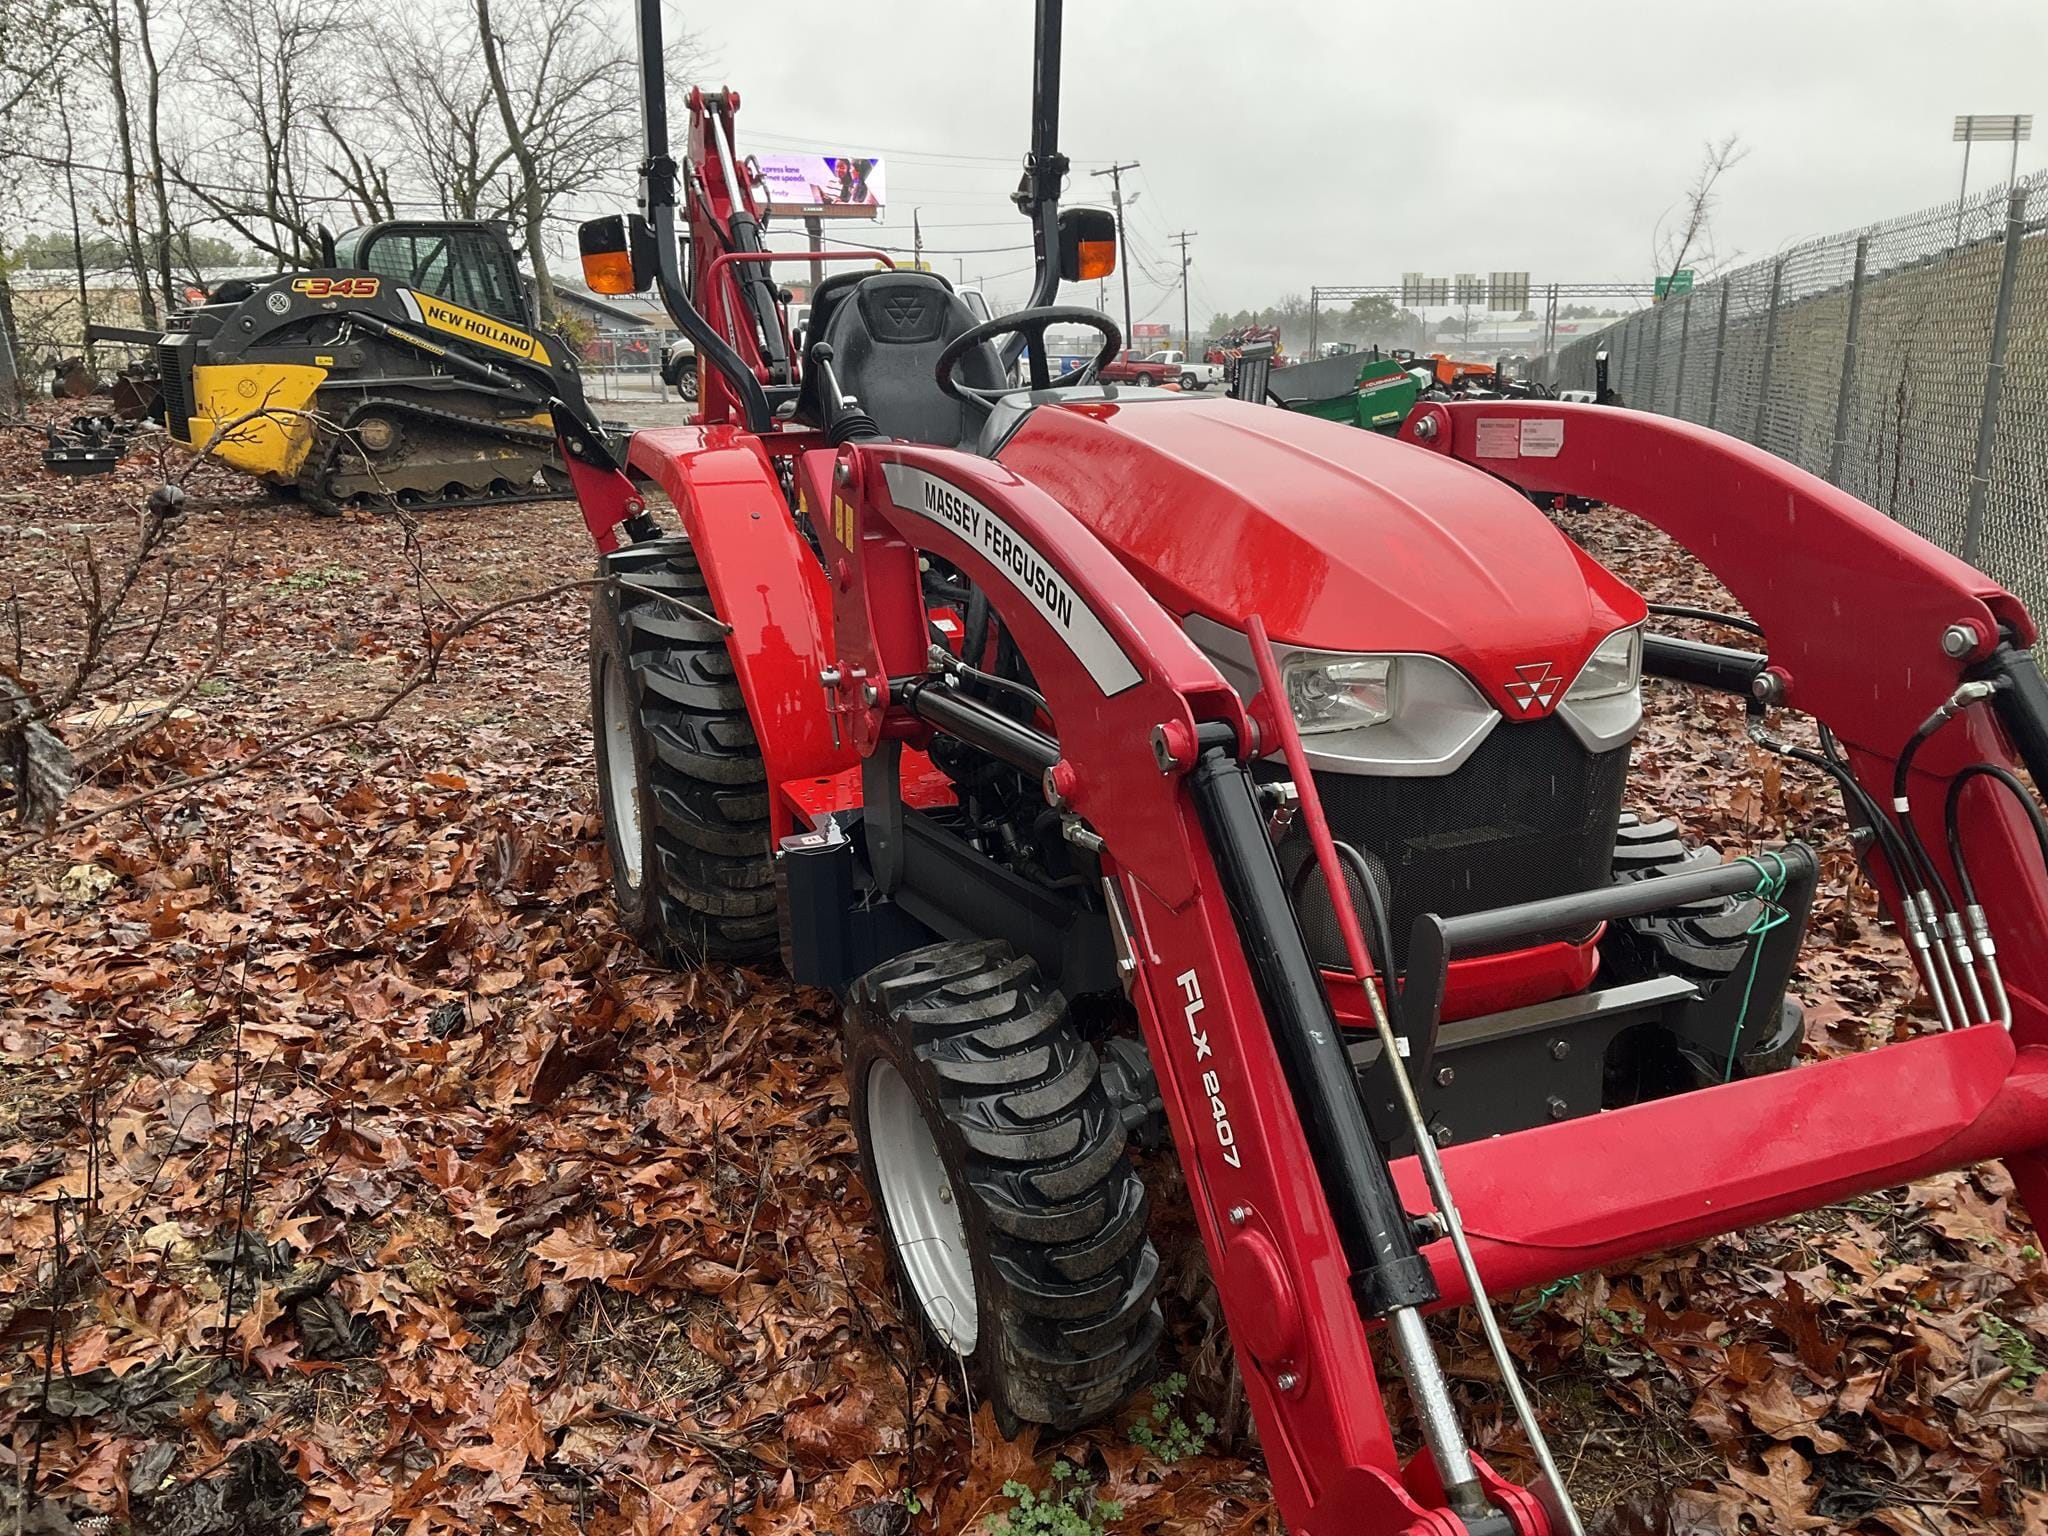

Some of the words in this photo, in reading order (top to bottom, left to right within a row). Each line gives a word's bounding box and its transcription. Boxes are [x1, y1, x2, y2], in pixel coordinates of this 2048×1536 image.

[761, 166, 783, 174] xpress
[784, 164, 800, 173] lane
[781, 174, 805, 183] speeds
[428, 306, 462, 327] NEW
[465, 319, 530, 351] HOLLAND
[925, 482, 980, 537] MASSEY
[984, 518, 1072, 629] FERGUSON
[1176, 968, 1213, 1063] FLX
[1202, 1070, 1242, 1169] 2407
